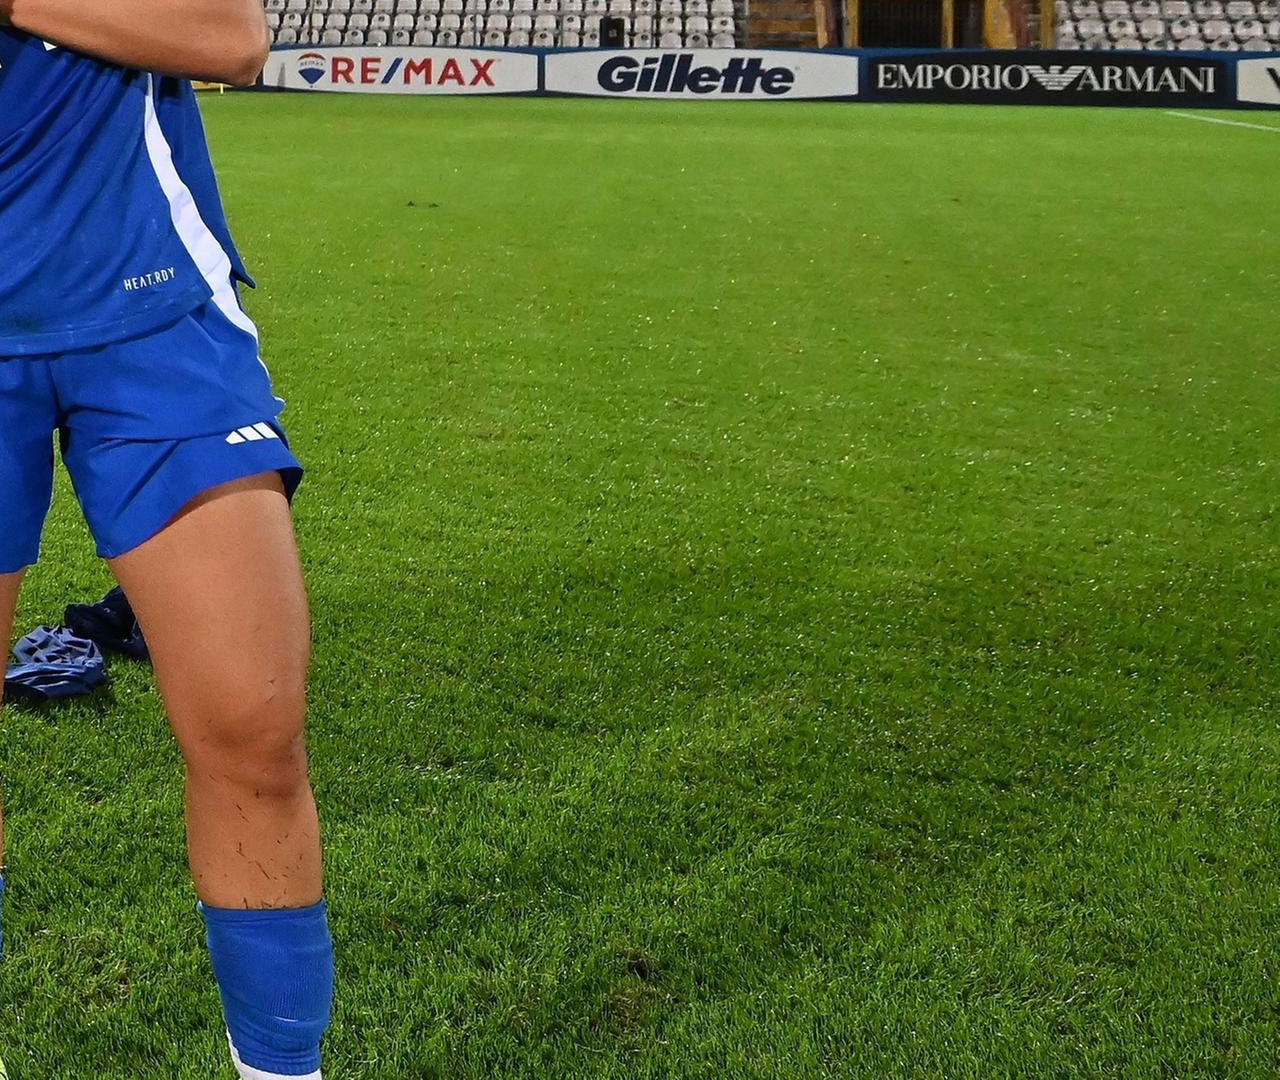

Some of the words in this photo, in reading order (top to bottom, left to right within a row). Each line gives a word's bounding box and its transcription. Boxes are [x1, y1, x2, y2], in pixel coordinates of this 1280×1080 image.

[330, 56, 496, 87] RE/MAX
[597, 53, 795, 95] Gillette
[876, 63, 1030, 91] EMPORIO
[1076, 64, 1216, 93] ARMANI
[123, 266, 175, 291] HEAT.RDY
